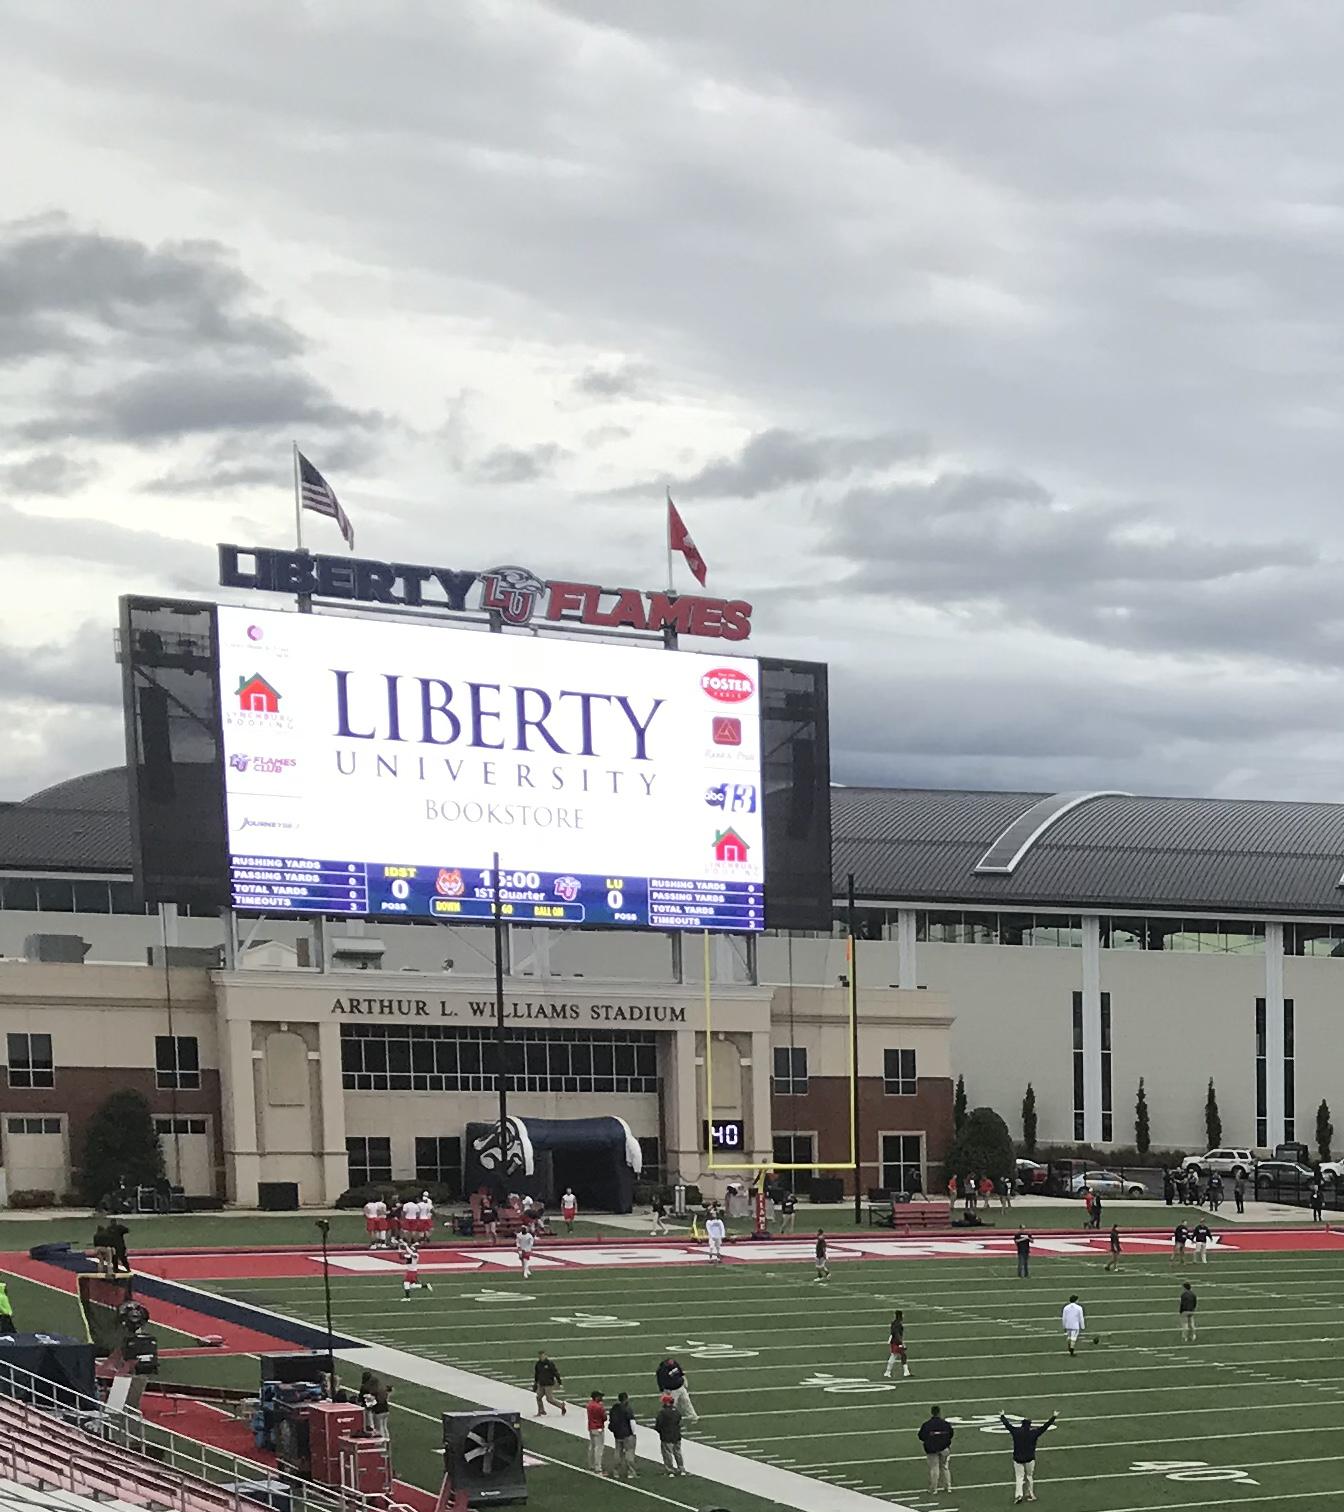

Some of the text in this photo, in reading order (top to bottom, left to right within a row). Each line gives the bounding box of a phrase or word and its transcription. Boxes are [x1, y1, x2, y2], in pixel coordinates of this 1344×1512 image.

[217, 543, 478, 612] LIBERTY
[546, 580, 753, 640] FLAMES
[702, 676, 752, 692] FOSTER
[329, 669, 666, 761] LIBERTY
[253, 757, 297, 767] FLAMES
[253, 764, 282, 773] CLUB
[336, 750, 656, 796] UNIVERSITY
[426, 798, 584, 829] BOOKSTORE
[233, 857, 355, 872] RUSHING YARDS 0
[234, 870, 281, 881] PASSING
[284, 872, 320, 883] YARDS
[384, 866, 416, 878] IDST
[480, 870, 540, 889] 15:00
[606, 879, 623, 889] LU
[652, 880, 695, 889] RUSHING
[697, 882, 726, 891] YARDS
[234, 884, 269, 894] TOTAL
[272, 885, 308, 896] YARDS
[392, 880, 409, 899] 0
[474, 887, 545, 900] 1ST Quarter
[235, 896, 357, 910] TIMEOUTS 3
[607, 890, 623, 909] 0
[653, 892, 692, 901] PASSING
[695, 894, 724, 903] YARDS
[381, 902, 407, 910] POSS
[436, 901, 461, 912] DOWN
[653, 905, 682, 913] TOTAL
[684, 906, 714, 915] YARDS
[614, 913, 637, 921] POSS
[653, 916, 700, 925] TIMEOUTS
[331, 998, 687, 1023] ARTHUR L. WILLIAMS STADIUM
[712, 1124, 738, 1145] 40
[1129, 1461, 1249, 1481] 40
